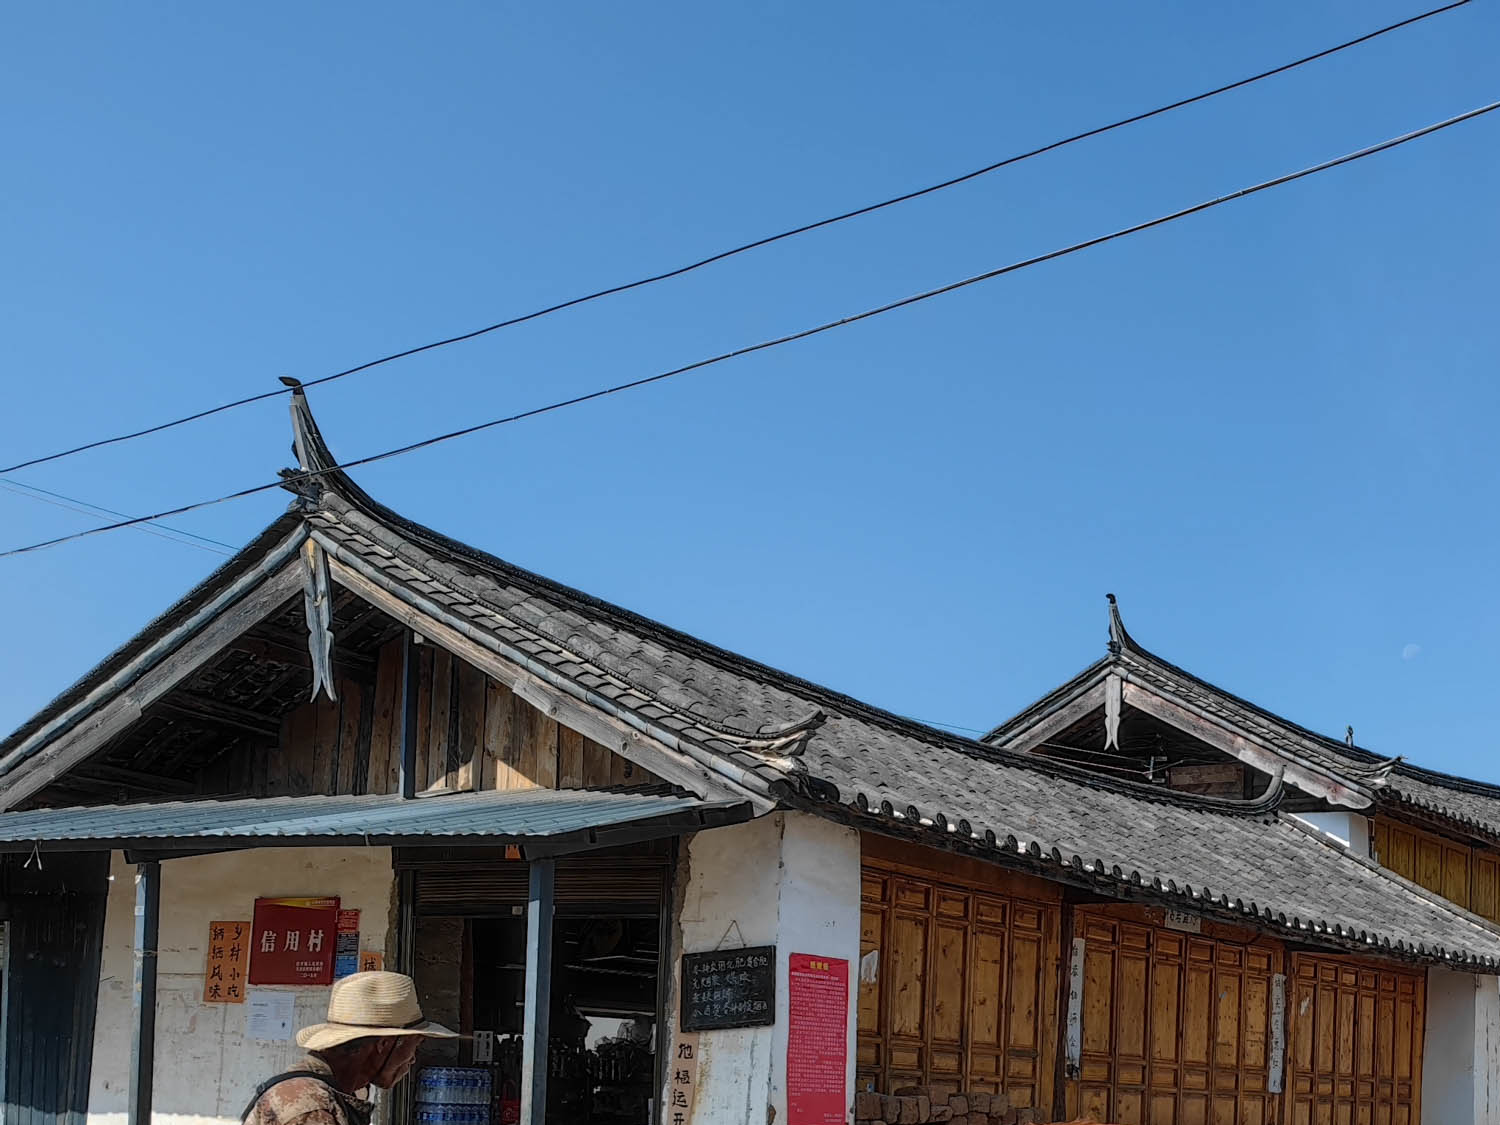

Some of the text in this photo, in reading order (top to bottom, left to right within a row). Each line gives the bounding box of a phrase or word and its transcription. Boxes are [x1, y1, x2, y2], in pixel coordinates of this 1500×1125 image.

[227, 924, 242, 998] 乡村小吃
[261, 930, 324, 952] 信用村
